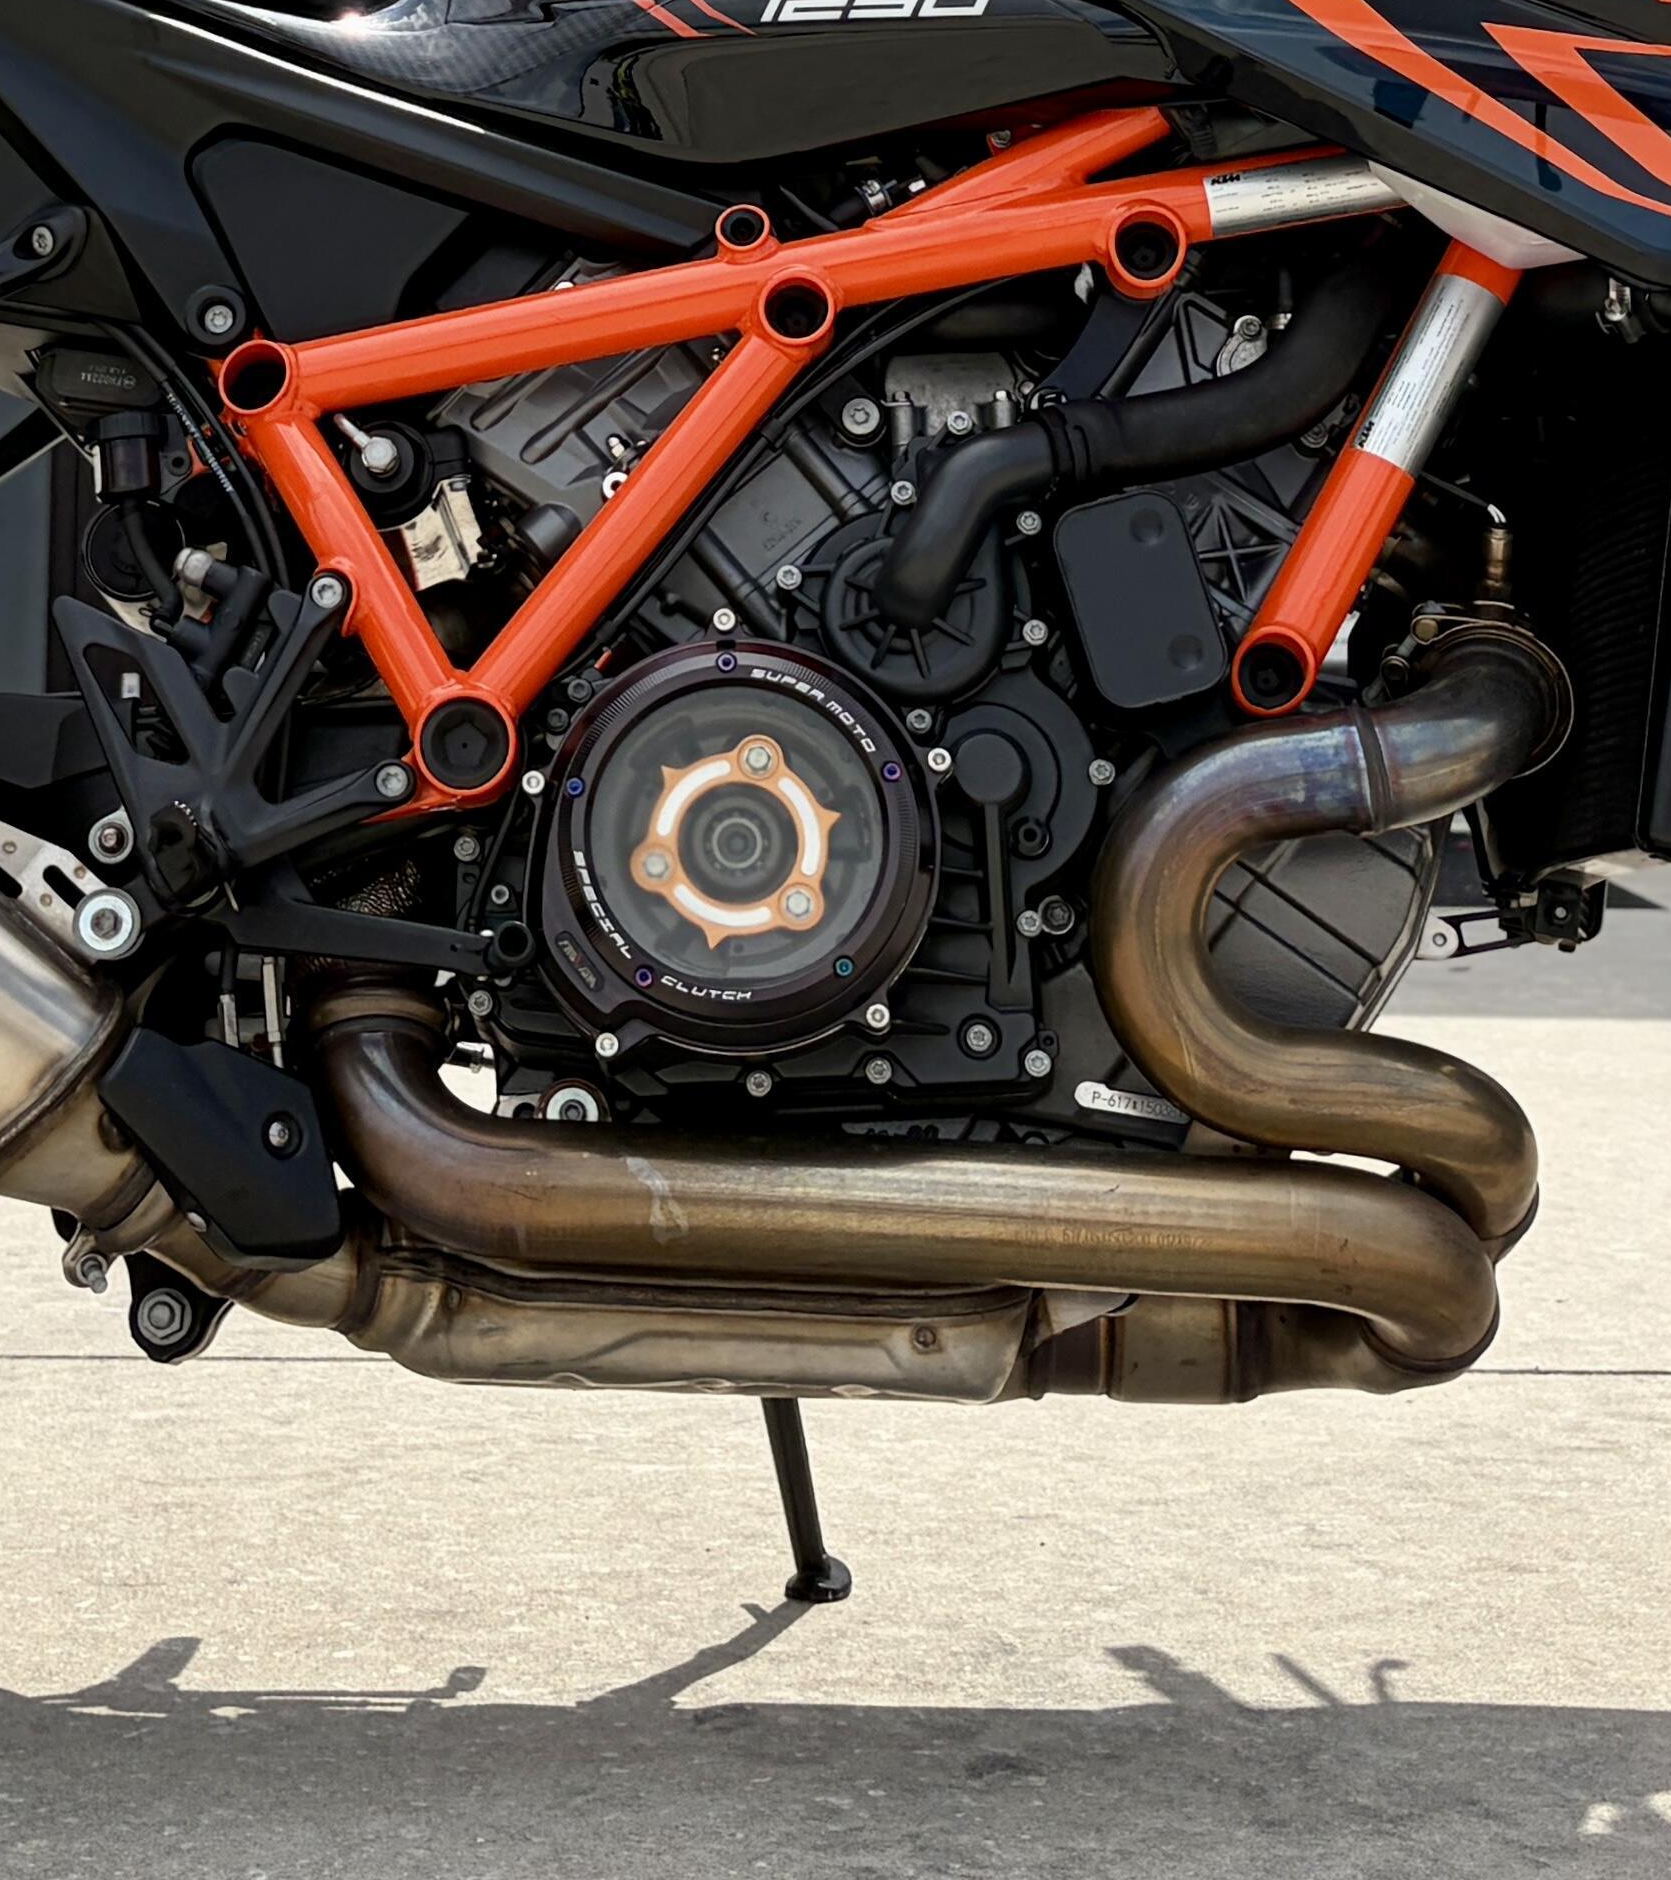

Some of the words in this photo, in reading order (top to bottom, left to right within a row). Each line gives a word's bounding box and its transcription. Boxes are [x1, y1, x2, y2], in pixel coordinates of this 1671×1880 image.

[750, 669, 826, 702] SUPER
[825, 699, 876, 753] MOTO
[572, 850, 633, 959] SPECIAL
[660, 974, 753, 1001] CLUTCH
